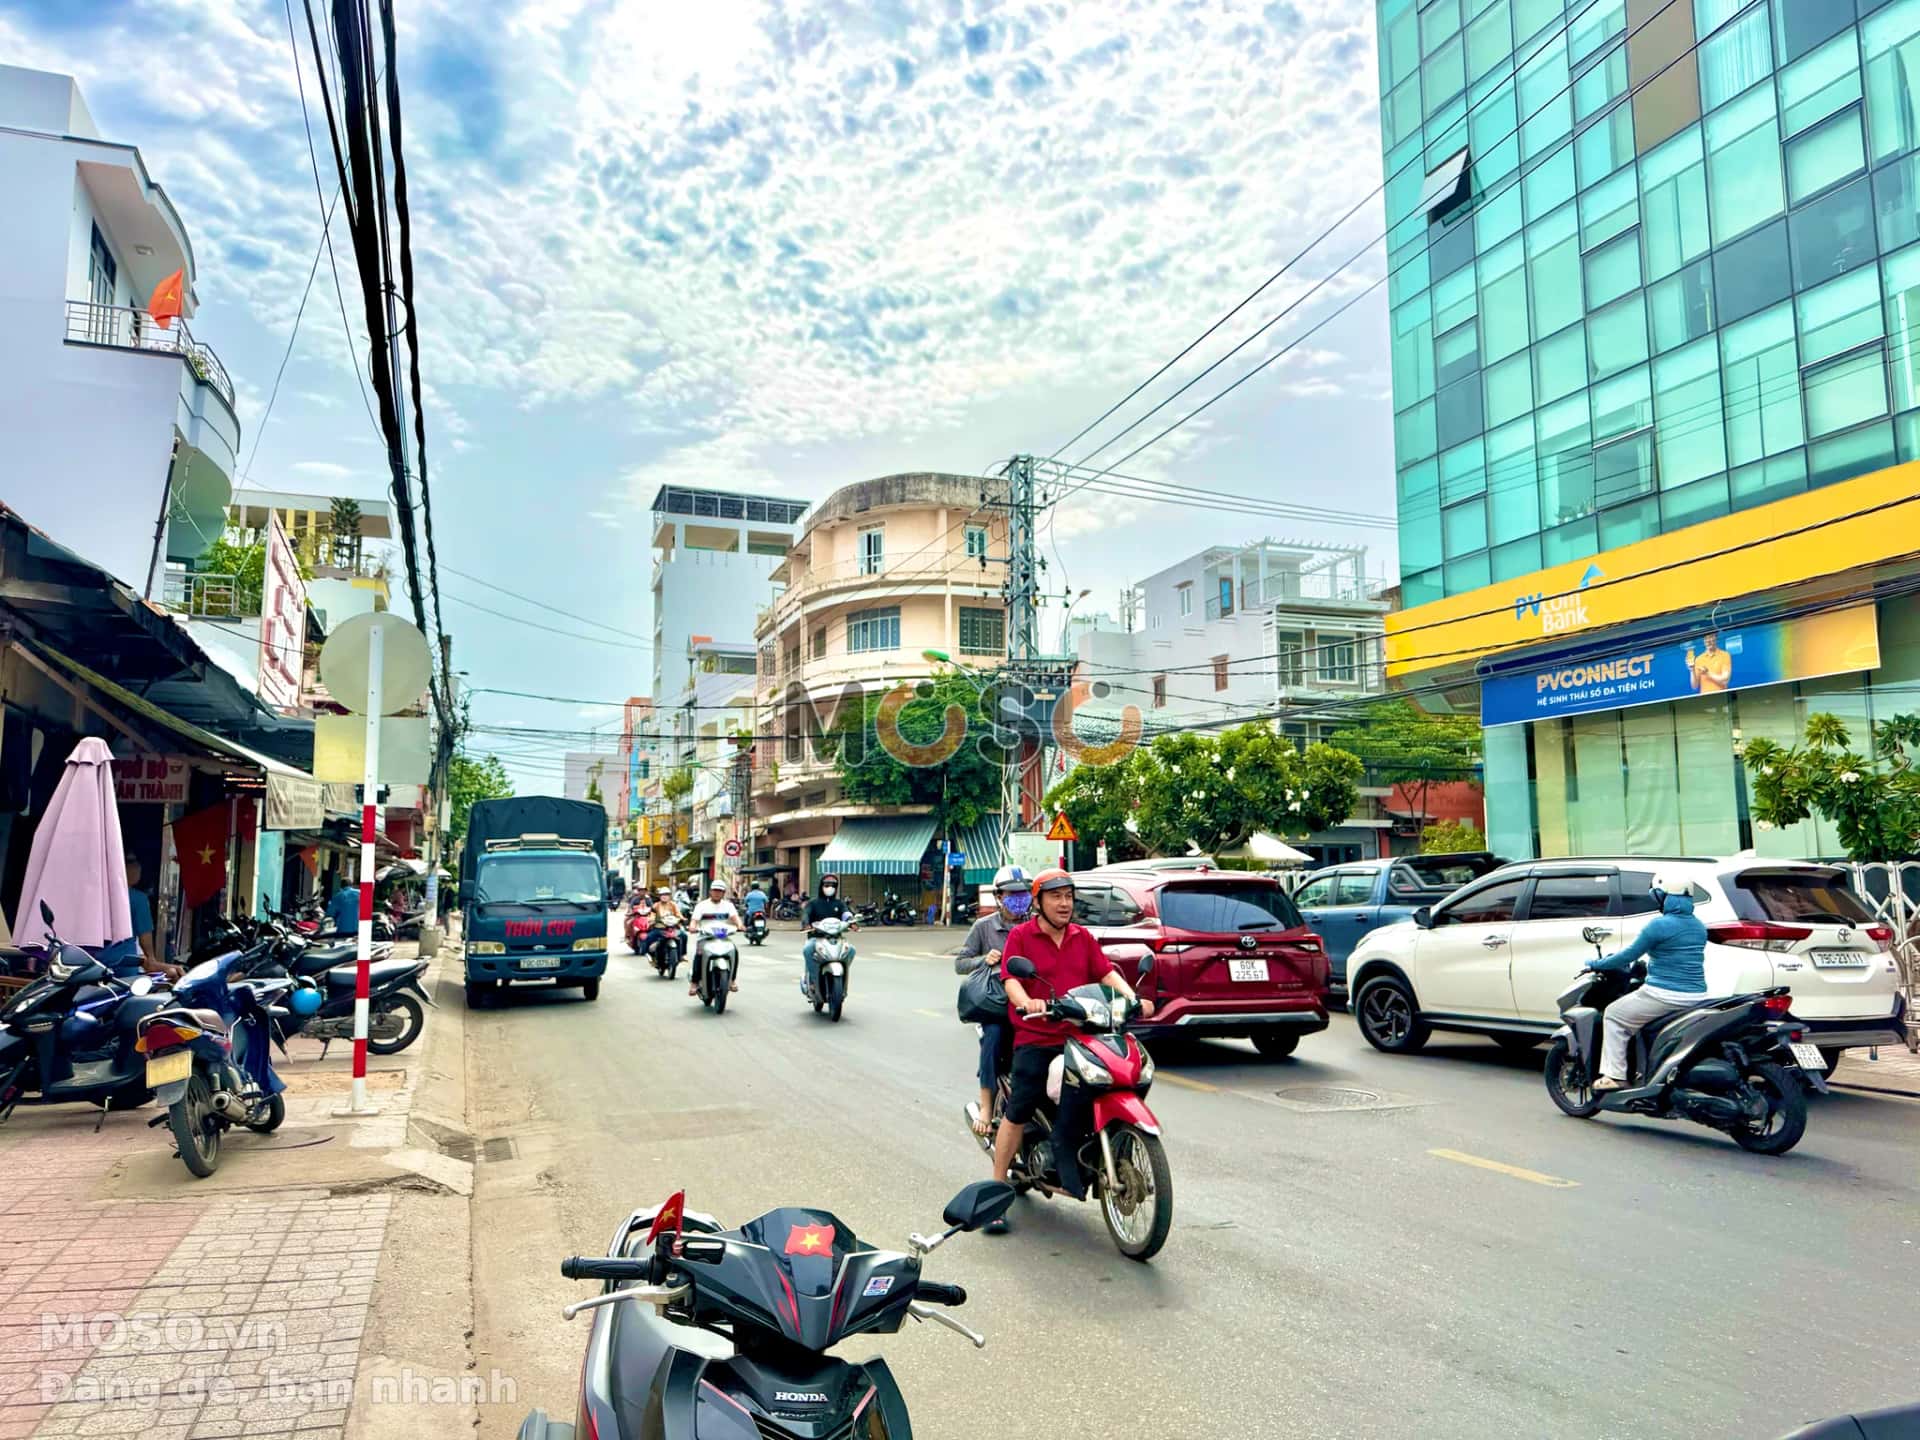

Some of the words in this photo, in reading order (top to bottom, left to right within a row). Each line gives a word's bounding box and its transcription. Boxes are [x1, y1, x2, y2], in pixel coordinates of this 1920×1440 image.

[1543, 607, 1590, 633] Bank
[1537, 654, 1655, 693] PVCONNECT
[1536, 695, 1548, 707] HỆ
[1550, 694, 1568, 705] SINH
[1570, 690, 1588, 702] THÁI
[1590, 686, 1601, 698] SỐ
[1603, 687, 1616, 696] ĐA
[1617, 682, 1637, 694] TIỆN
[1639, 679, 1655, 689] ÍCH
[774, 1391, 829, 1402] HONDA
